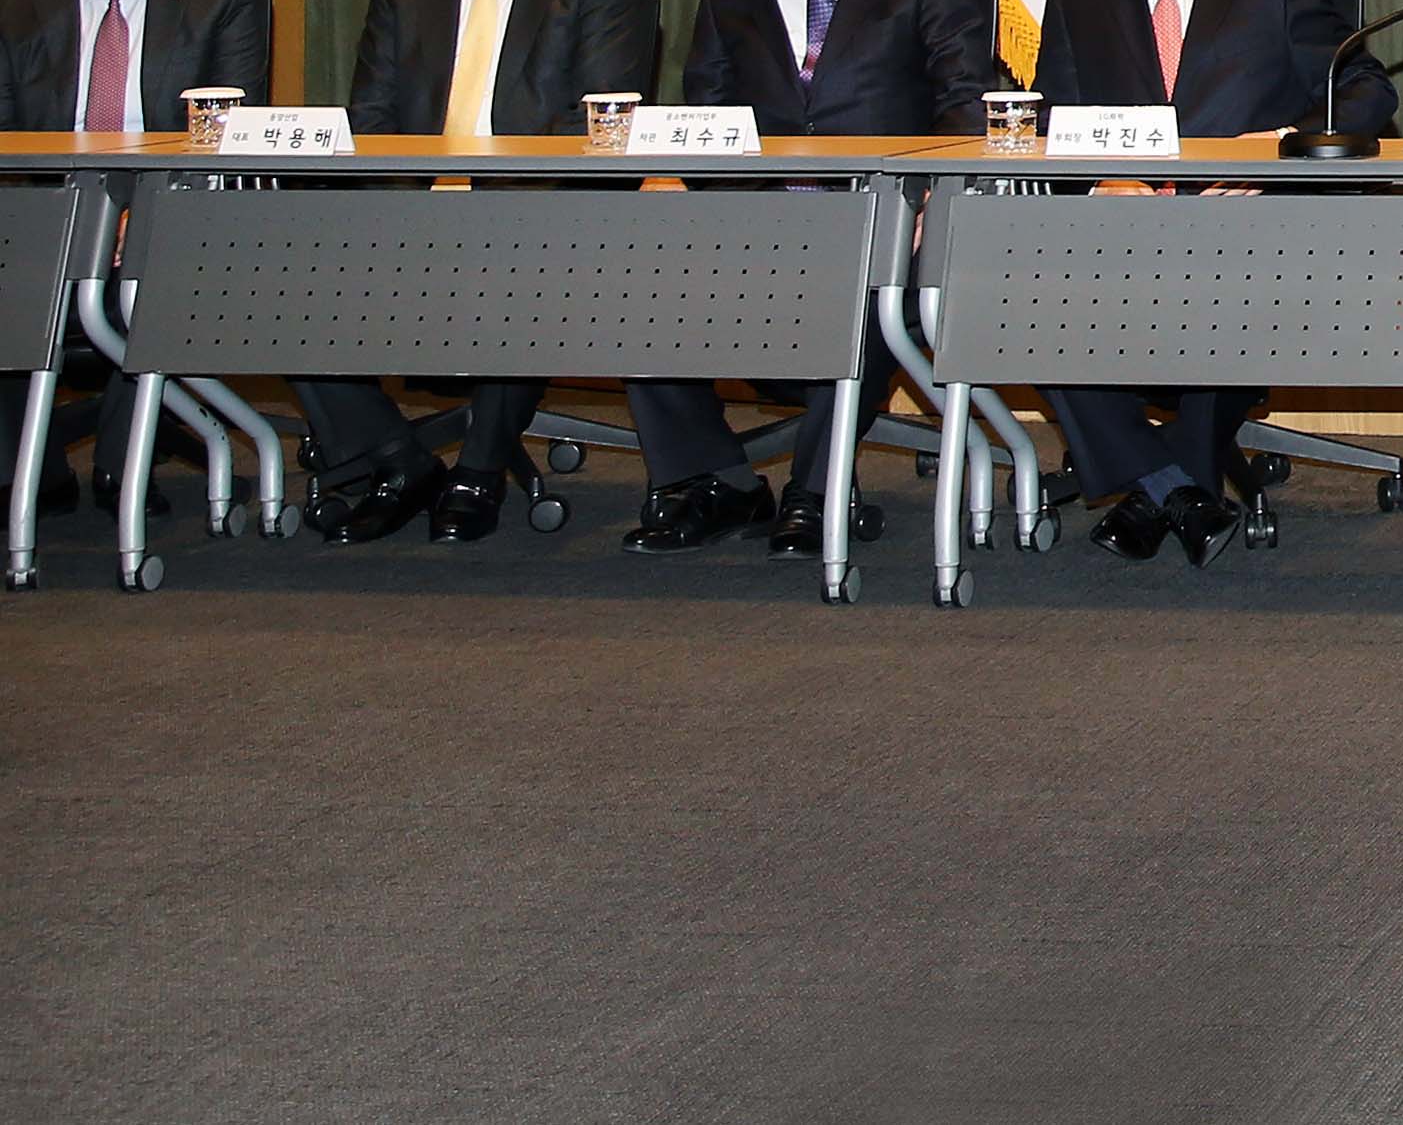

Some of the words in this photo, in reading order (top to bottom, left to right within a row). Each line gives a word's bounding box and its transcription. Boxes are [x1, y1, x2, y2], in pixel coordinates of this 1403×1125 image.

[231, 132, 249, 142] 대표
[263, 127, 333, 149] 박용해
[669, 126, 741, 147] 최수규
[1091, 127, 1165, 149] 박진수
